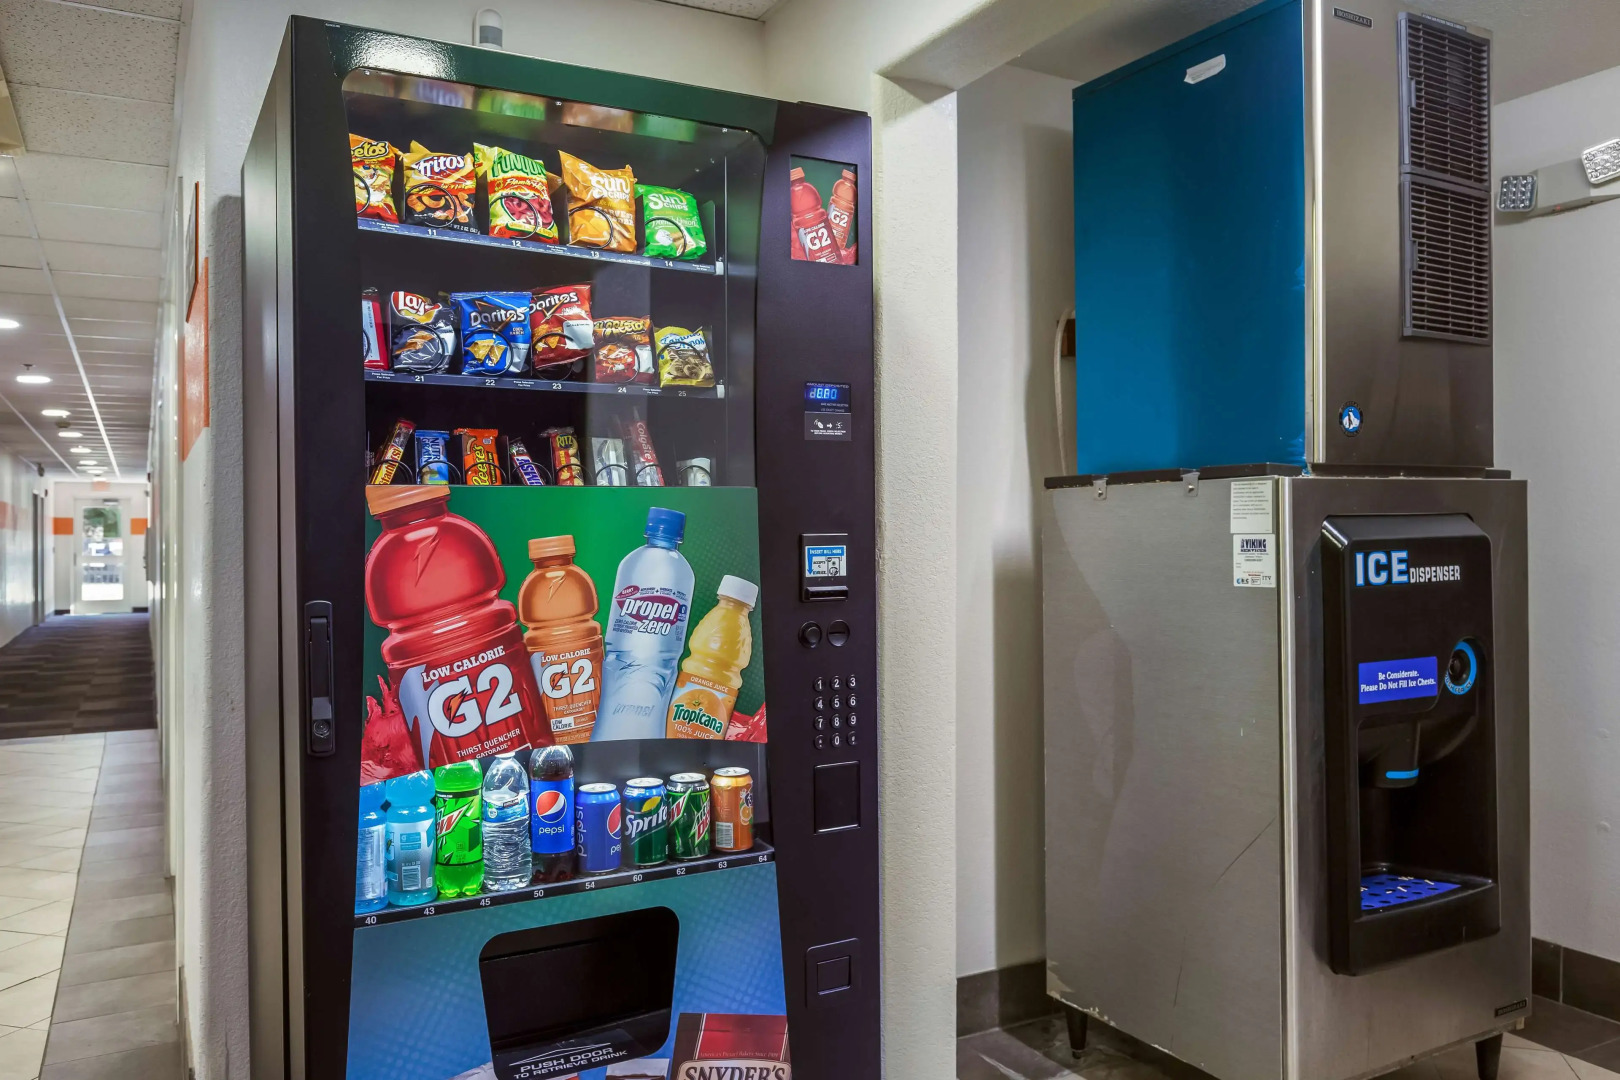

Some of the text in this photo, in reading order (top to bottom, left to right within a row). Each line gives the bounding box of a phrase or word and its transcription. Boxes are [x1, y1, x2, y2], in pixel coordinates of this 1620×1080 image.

[351, 140, 387, 157] etos
[418, 155, 465, 177] Fritos
[648, 193, 687, 210] Sun
[664, 202, 688, 211] CHIPS
[830, 210, 849, 228] G2
[427, 228, 437, 236] 11
[806, 227, 832, 251] G2
[511, 239, 521, 247] 12
[590, 250, 600, 258] 13
[664, 260, 674, 268] 14
[397, 291, 426, 316] Lay
[470, 307, 526, 327] Doritos
[552, 382, 562, 390] 23
[556, 435, 574, 447] RITZ
[1355, 550, 1460, 587] ICE DISPENSER
[620, 598, 679, 620] propel
[638, 619, 671, 636] zero
[541, 648, 591, 663] LOW CALORIE
[421, 645, 506, 683] LOW CALORIE
[541, 658, 595, 699] G2
[817, 677, 856, 689] 1 2 3
[1378, 670, 1420, 681] Be Considerate.
[690, 676, 729, 693] ORANGE JUICE
[1360, 678, 1437, 693] Please Do Not Fill Ice Chests.
[427, 662, 523, 738] G2
[817, 696, 856, 709] 4 5 6
[673, 703, 724, 734] Tropicana
[818, 715, 856, 728] 7 8 9
[674, 723, 693, 734] 100%
[693, 727, 715, 739] JUICE
[456, 728, 521, 758] THIRST QUENCHER
[834, 735, 840, 745] 0
[538, 824, 565, 836] pepsi
[576, 805, 588, 857] pepsi
[633, 874, 643, 882] 60
[676, 868, 686, 876] 62
[533, 890, 544, 898] 50
[479, 898, 491, 906] 45
[423, 907, 435, 915] 43
[365, 916, 377, 924] 40
[520, 1047, 613, 1073] PUSH DOOR
[533, 1059, 589, 1076] RETRIEVE
[591, 1050, 628, 1063] DRINK
